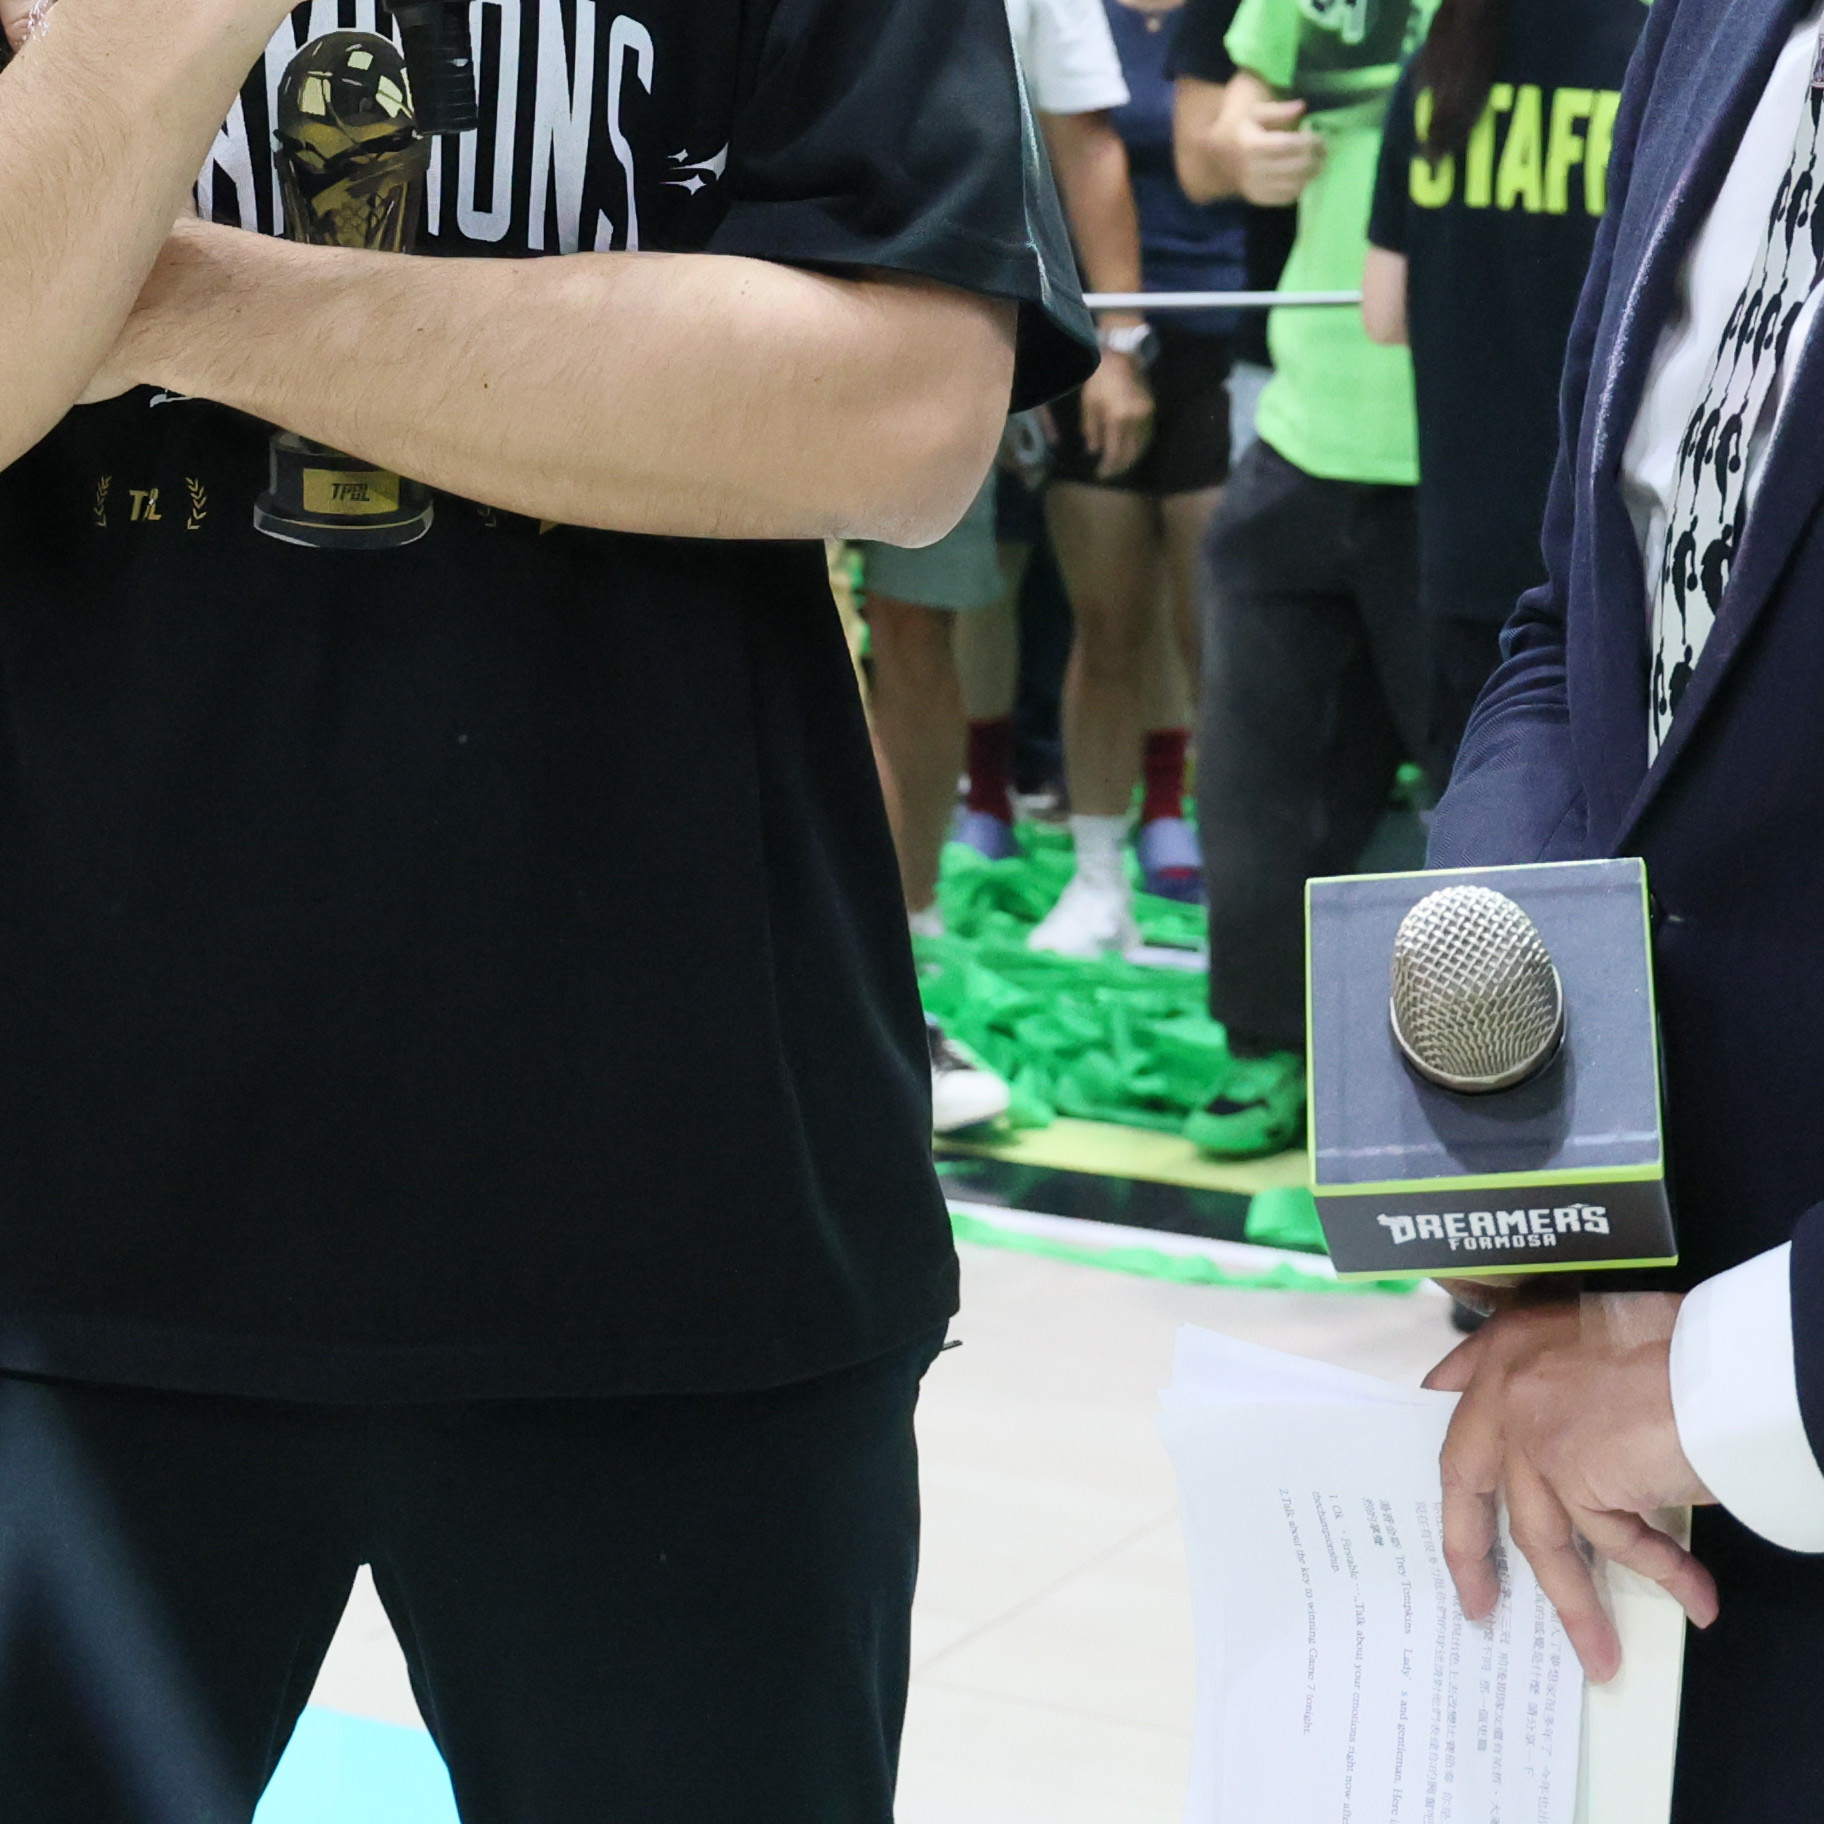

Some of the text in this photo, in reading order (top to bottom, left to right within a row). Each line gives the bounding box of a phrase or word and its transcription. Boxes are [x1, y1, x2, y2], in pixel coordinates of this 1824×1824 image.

[1377, 1203, 1610, 1244] DREAMERS
[1449, 1233, 1557, 1251] FORMOSA
[1288, 1520, 1302, 1547] about
[1296, 1549, 1307, 1565] the
[1395, 1555, 1407, 1577] Trey
[1300, 1566, 1312, 1586] key
[1401, 1580, 1413, 1634] Tompkins
[1307, 1601, 1317, 1645] winning
[1355, 1630, 1366, 1661] about
[1307, 1647, 1318, 1681] Game
[1353, 1663, 1363, 1690] your
[1348, 1691, 1360, 1743] emotions
[1399, 1700, 1409, 1721] and
[1345, 1746, 1357, 1774] right
[1344, 1775, 1353, 1801] now
[1391, 1788, 1403, 1816] Here
